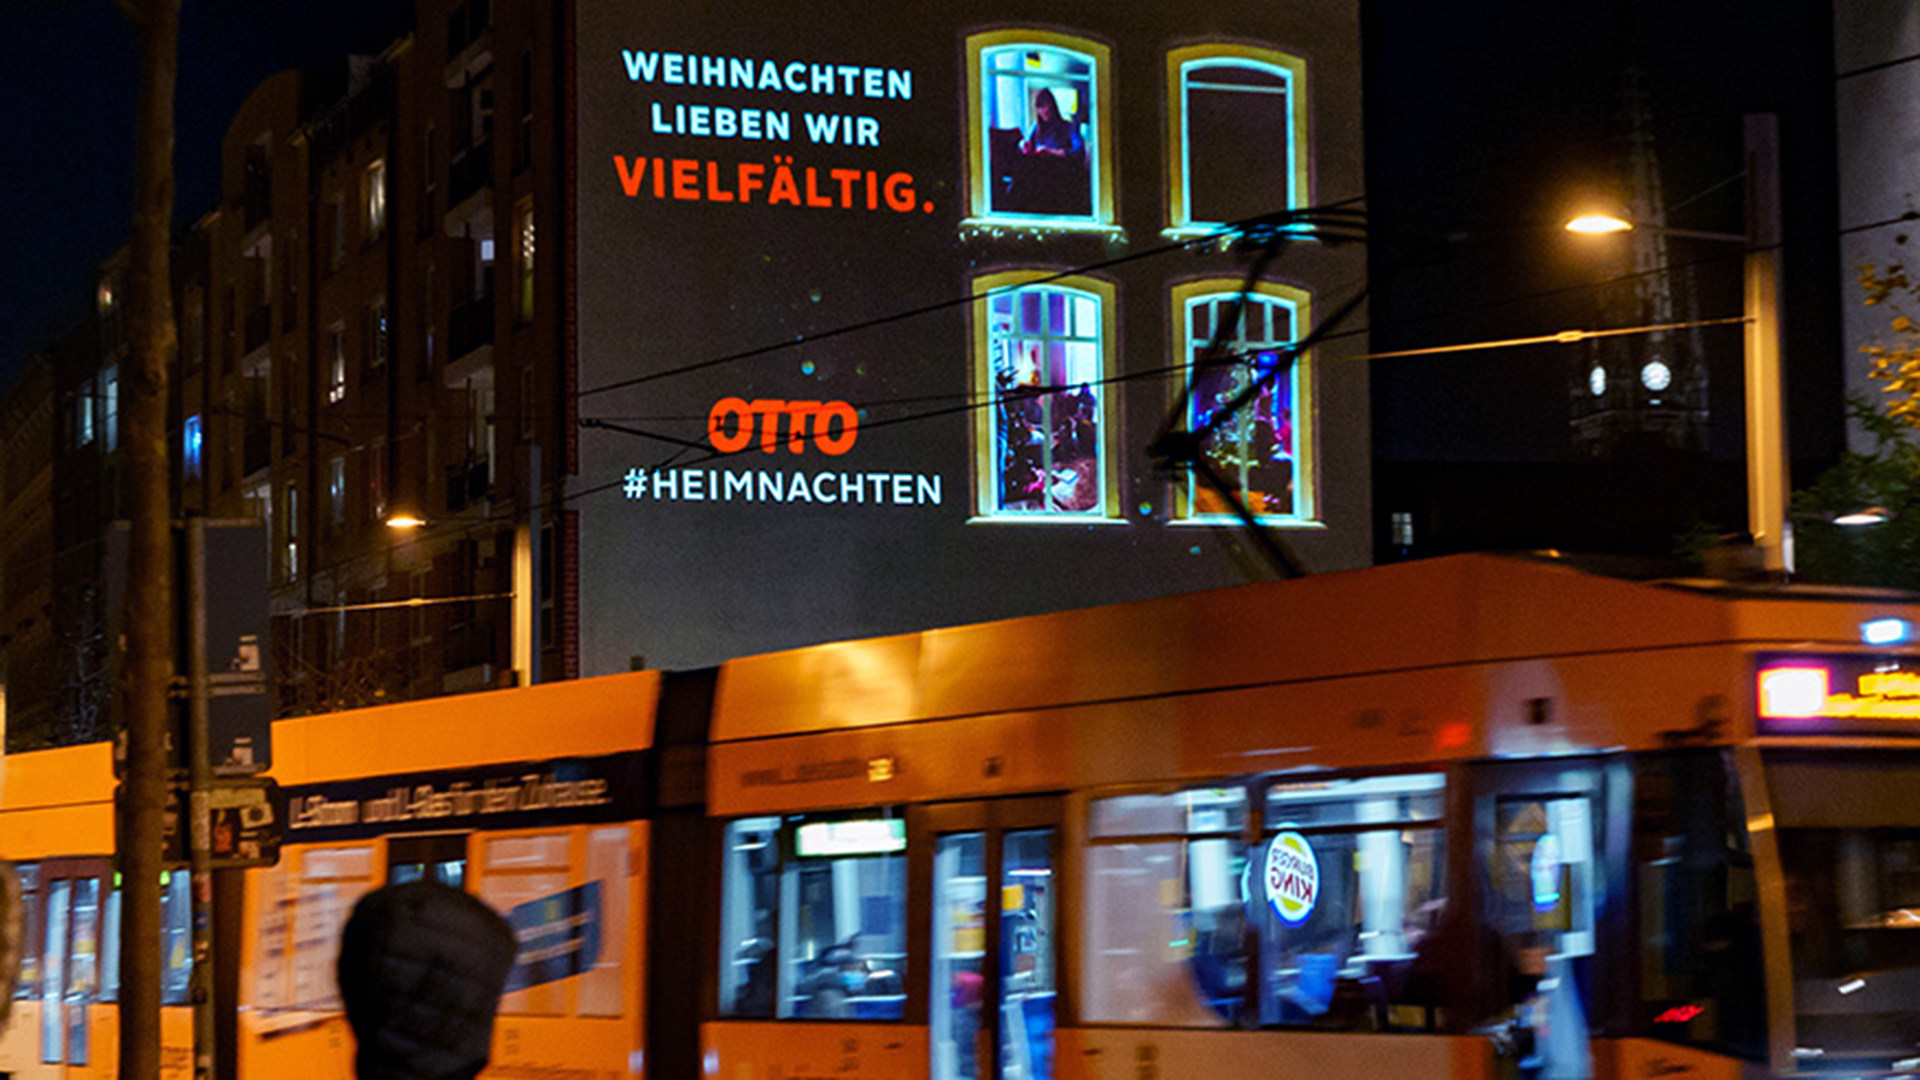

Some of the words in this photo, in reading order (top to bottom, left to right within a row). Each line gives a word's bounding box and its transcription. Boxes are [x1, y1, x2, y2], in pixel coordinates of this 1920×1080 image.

[622, 49, 912, 101] WEIHNACHTEN
[651, 102, 791, 141] LIEBEN
[804, 112, 881, 147] WIR
[613, 154, 935, 214] VIELFÄLTIG.
[708, 396, 859, 456] OTTO
[623, 467, 942, 505] #HEIMNACHTEN
